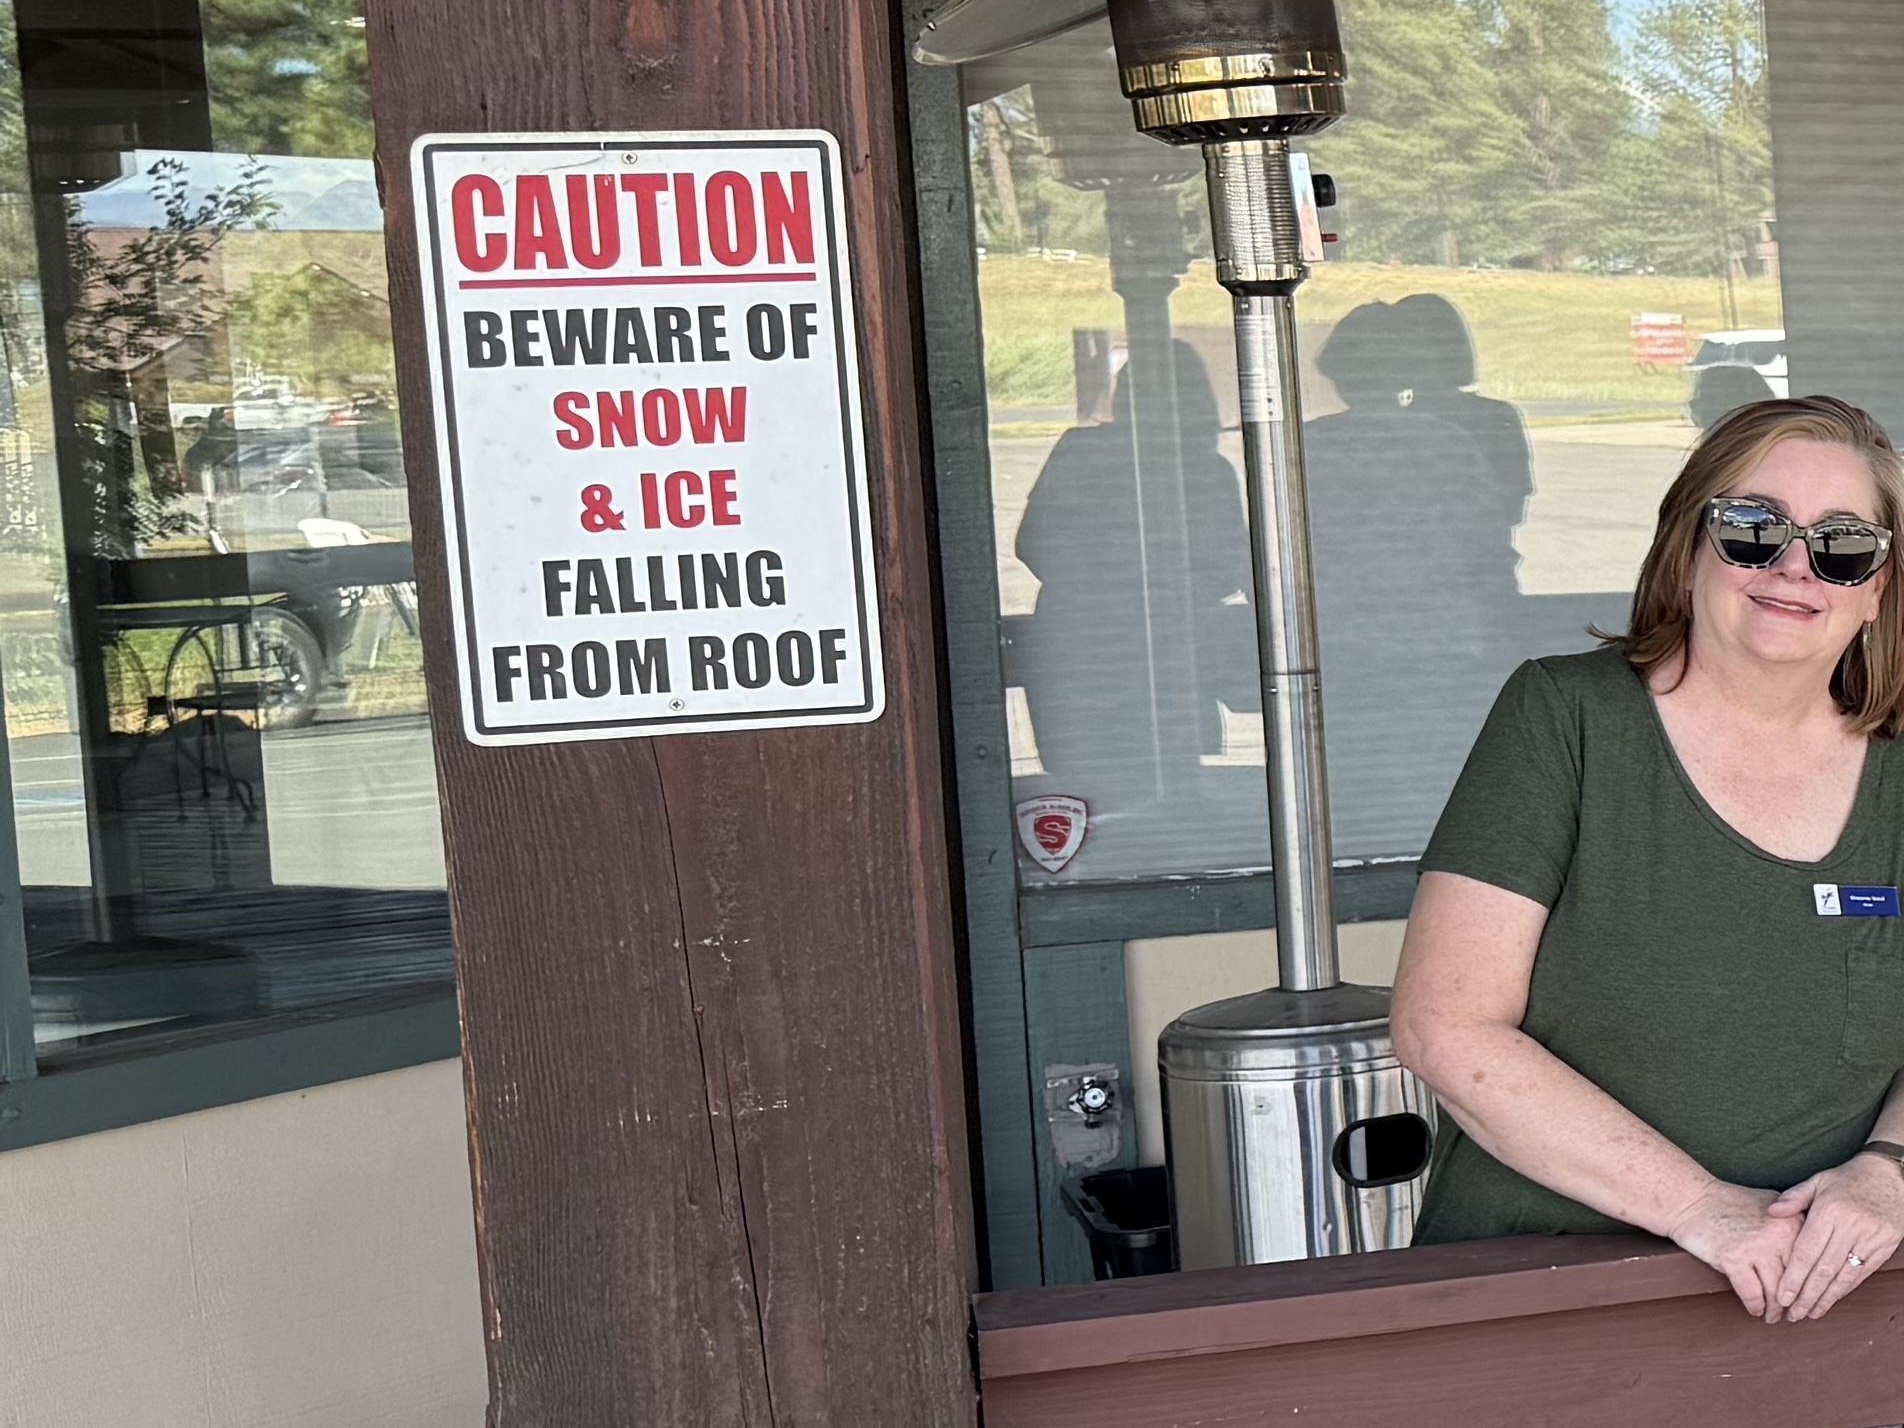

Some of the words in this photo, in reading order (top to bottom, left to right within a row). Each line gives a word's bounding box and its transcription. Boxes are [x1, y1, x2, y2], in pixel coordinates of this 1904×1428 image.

[451, 171, 815, 273] CAUTION
[463, 305, 731, 369] BEWARE
[746, 303, 818, 362] OF
[554, 387, 747, 451] SNOW
[580, 483, 625, 533] &
[640, 470, 742, 529] ICE
[541, 550, 787, 618] FALLING
[492, 637, 672, 704] FROM
[687, 628, 848, 693] ROOF
